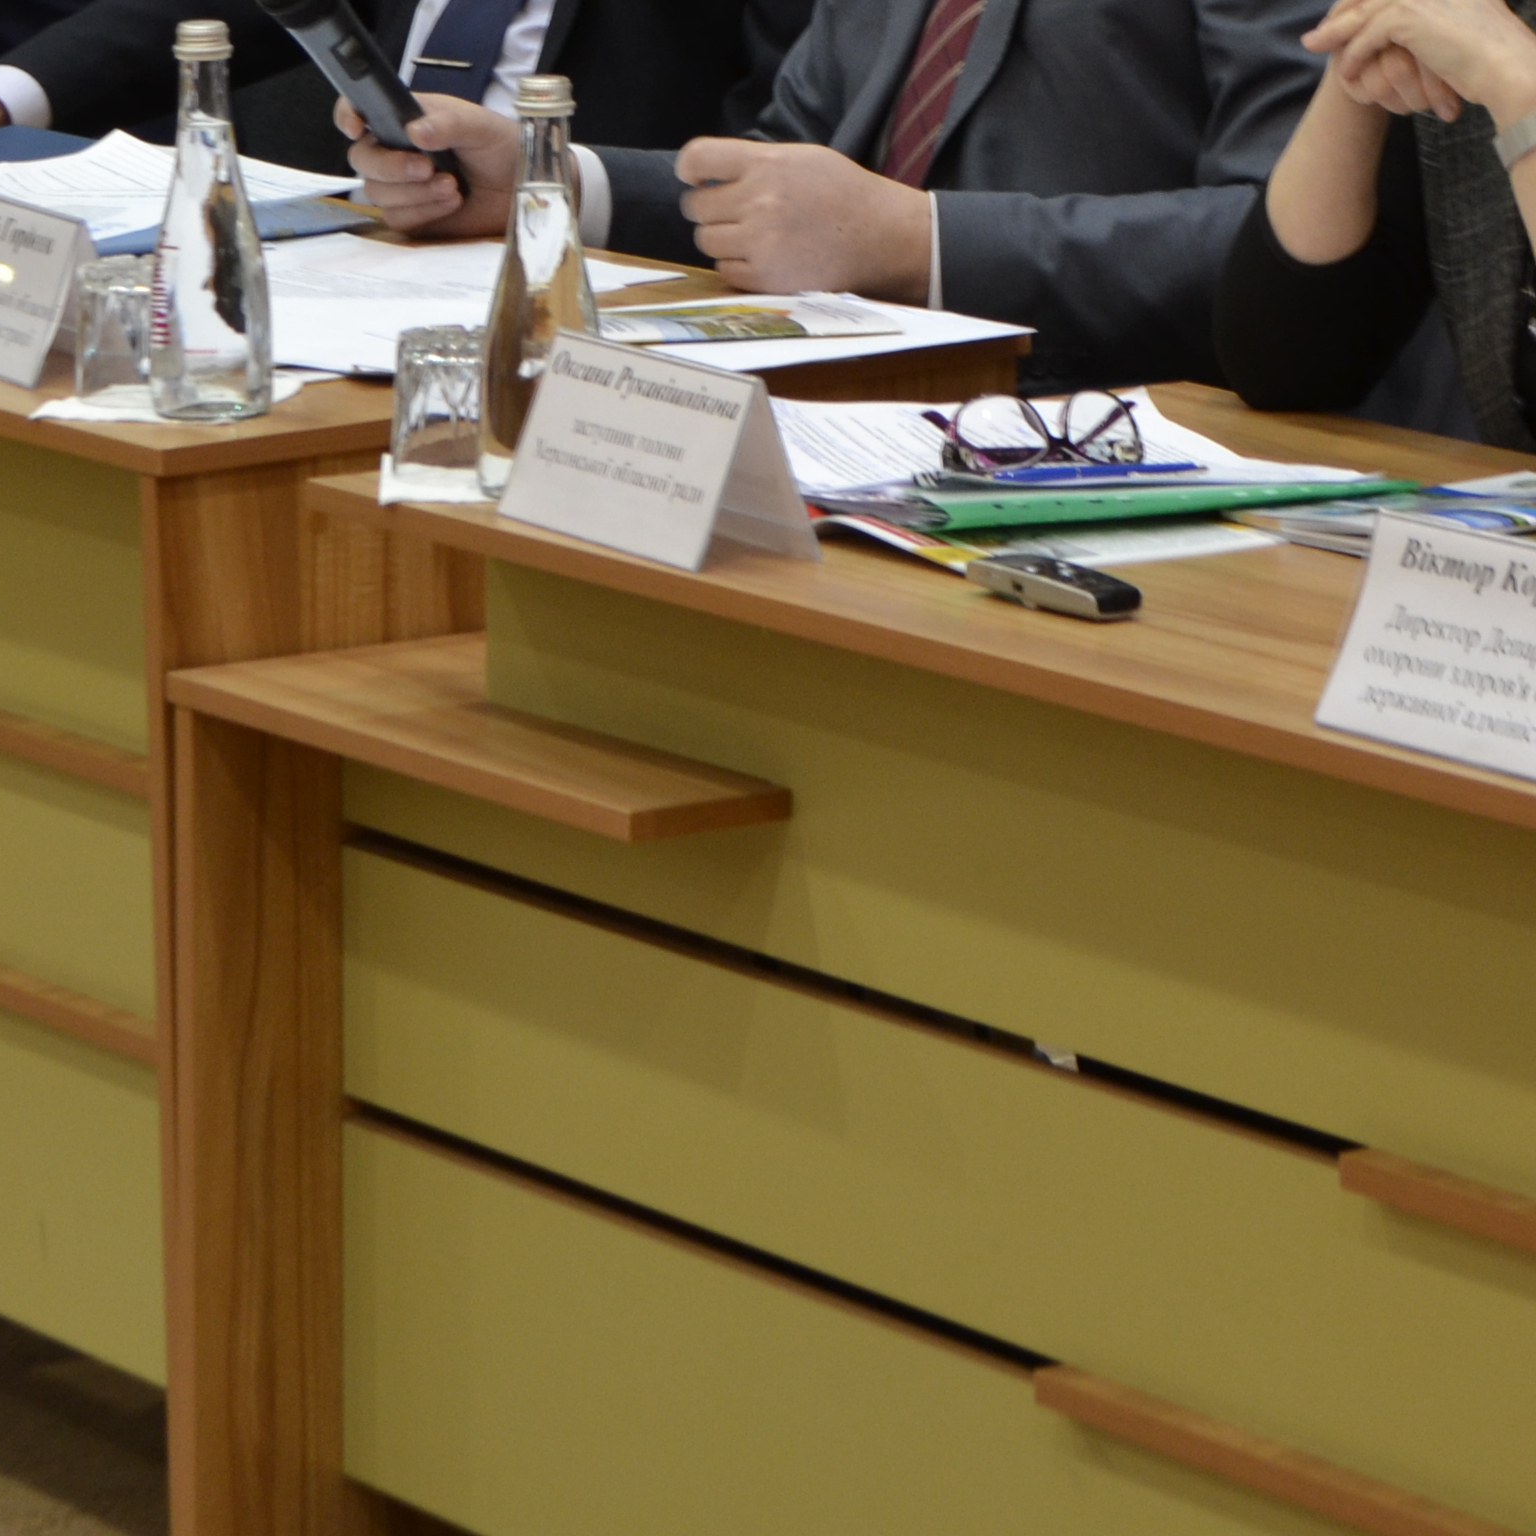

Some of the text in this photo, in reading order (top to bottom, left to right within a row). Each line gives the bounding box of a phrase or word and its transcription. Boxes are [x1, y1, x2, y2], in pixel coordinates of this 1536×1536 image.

[551, 350, 613, 385] Оксана
[1399, 537, 1497, 593] Віктор
[1385, 603, 1481, 652] Директор
